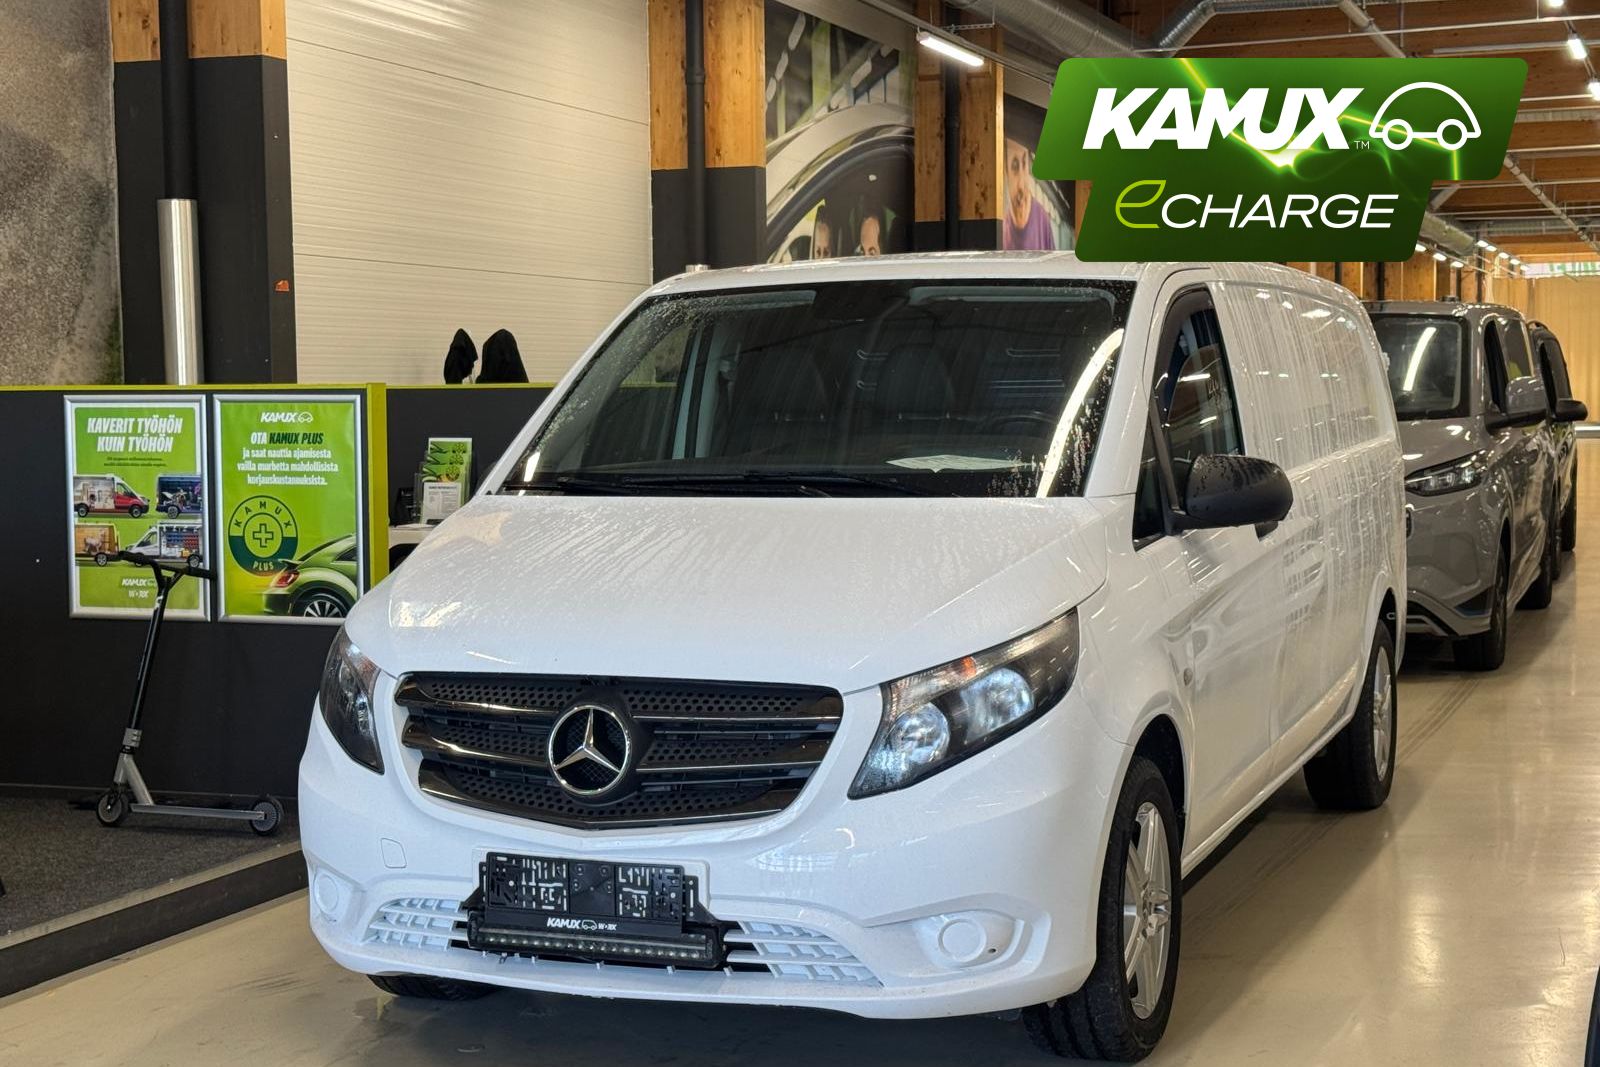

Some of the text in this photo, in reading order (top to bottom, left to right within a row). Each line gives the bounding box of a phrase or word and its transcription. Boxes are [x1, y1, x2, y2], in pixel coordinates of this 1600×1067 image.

[261, 412, 298, 422] KAMUX
[87, 414, 183, 433] KAVERIT TYÖHÖN
[96, 433, 174, 452] KUIN TYÖHÖN
[250, 432, 324, 444] OTA KAMUX PLUS
[242, 447, 332, 460] ja saat nauttia ajamisesta
[237, 461, 257, 471] vailla
[234, 501, 292, 528] KAMUX
[252, 561, 274, 571] PLUS
[546, 917, 581, 929] KAMUX
